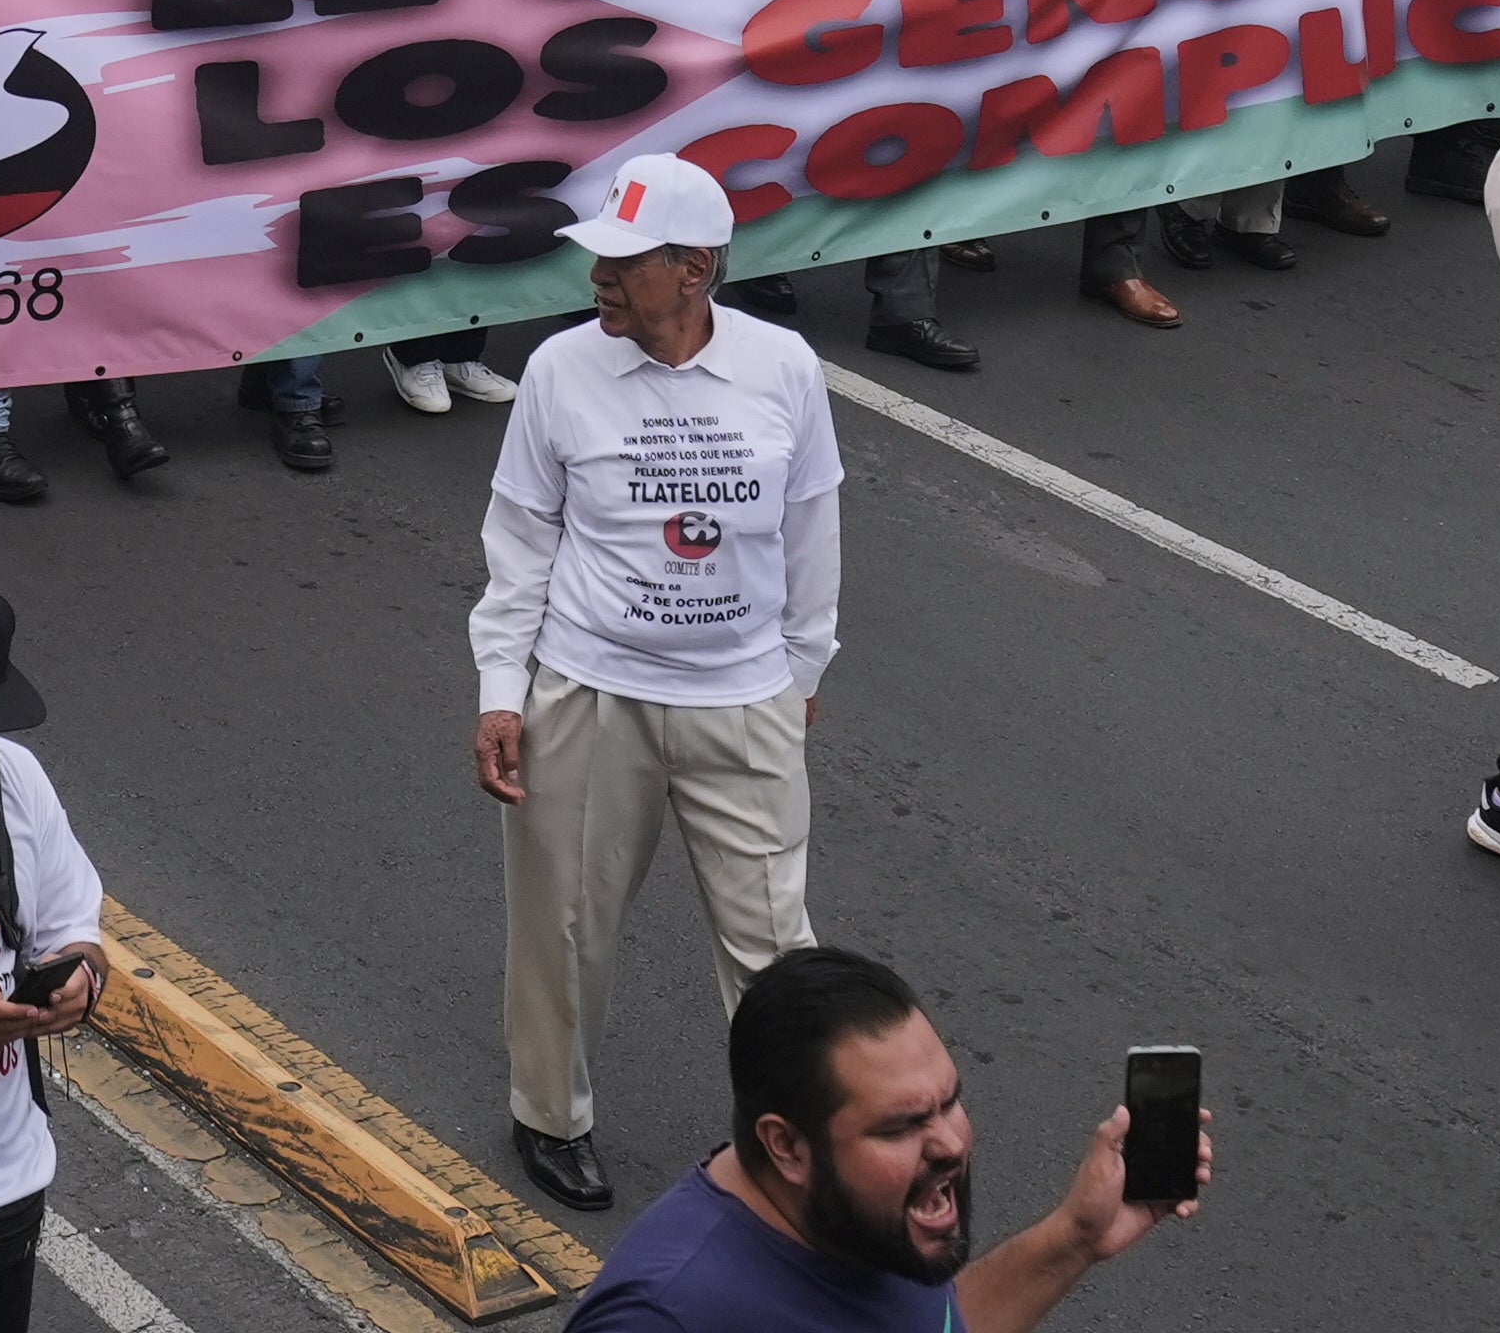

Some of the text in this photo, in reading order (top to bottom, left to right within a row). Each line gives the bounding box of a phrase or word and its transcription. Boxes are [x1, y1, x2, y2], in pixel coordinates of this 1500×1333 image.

[193, 17, 668, 167] LOS
[296, 159, 581, 290] ES
[642, 416, 719, 429] SOMOS LA TRIBU
[623, 432, 744, 446] SIN ROSTRO Y SIN NOMBRE
[644, 450, 677, 461] SOMOS
[679, 450, 698, 460] LOS
[700, 449, 721, 461] QUE
[723, 447, 755, 460] HEMOS
[634, 465, 744, 478] PELEADO POR SIEMPRE
[628, 479, 761, 505] TLATELOLCO
[664, 559, 717, 576] COMITÉ 68
[641, 593, 740, 609] 2 DE OCTUBRE
[623, 605, 752, 625] ¡NO OLVIDADO!
